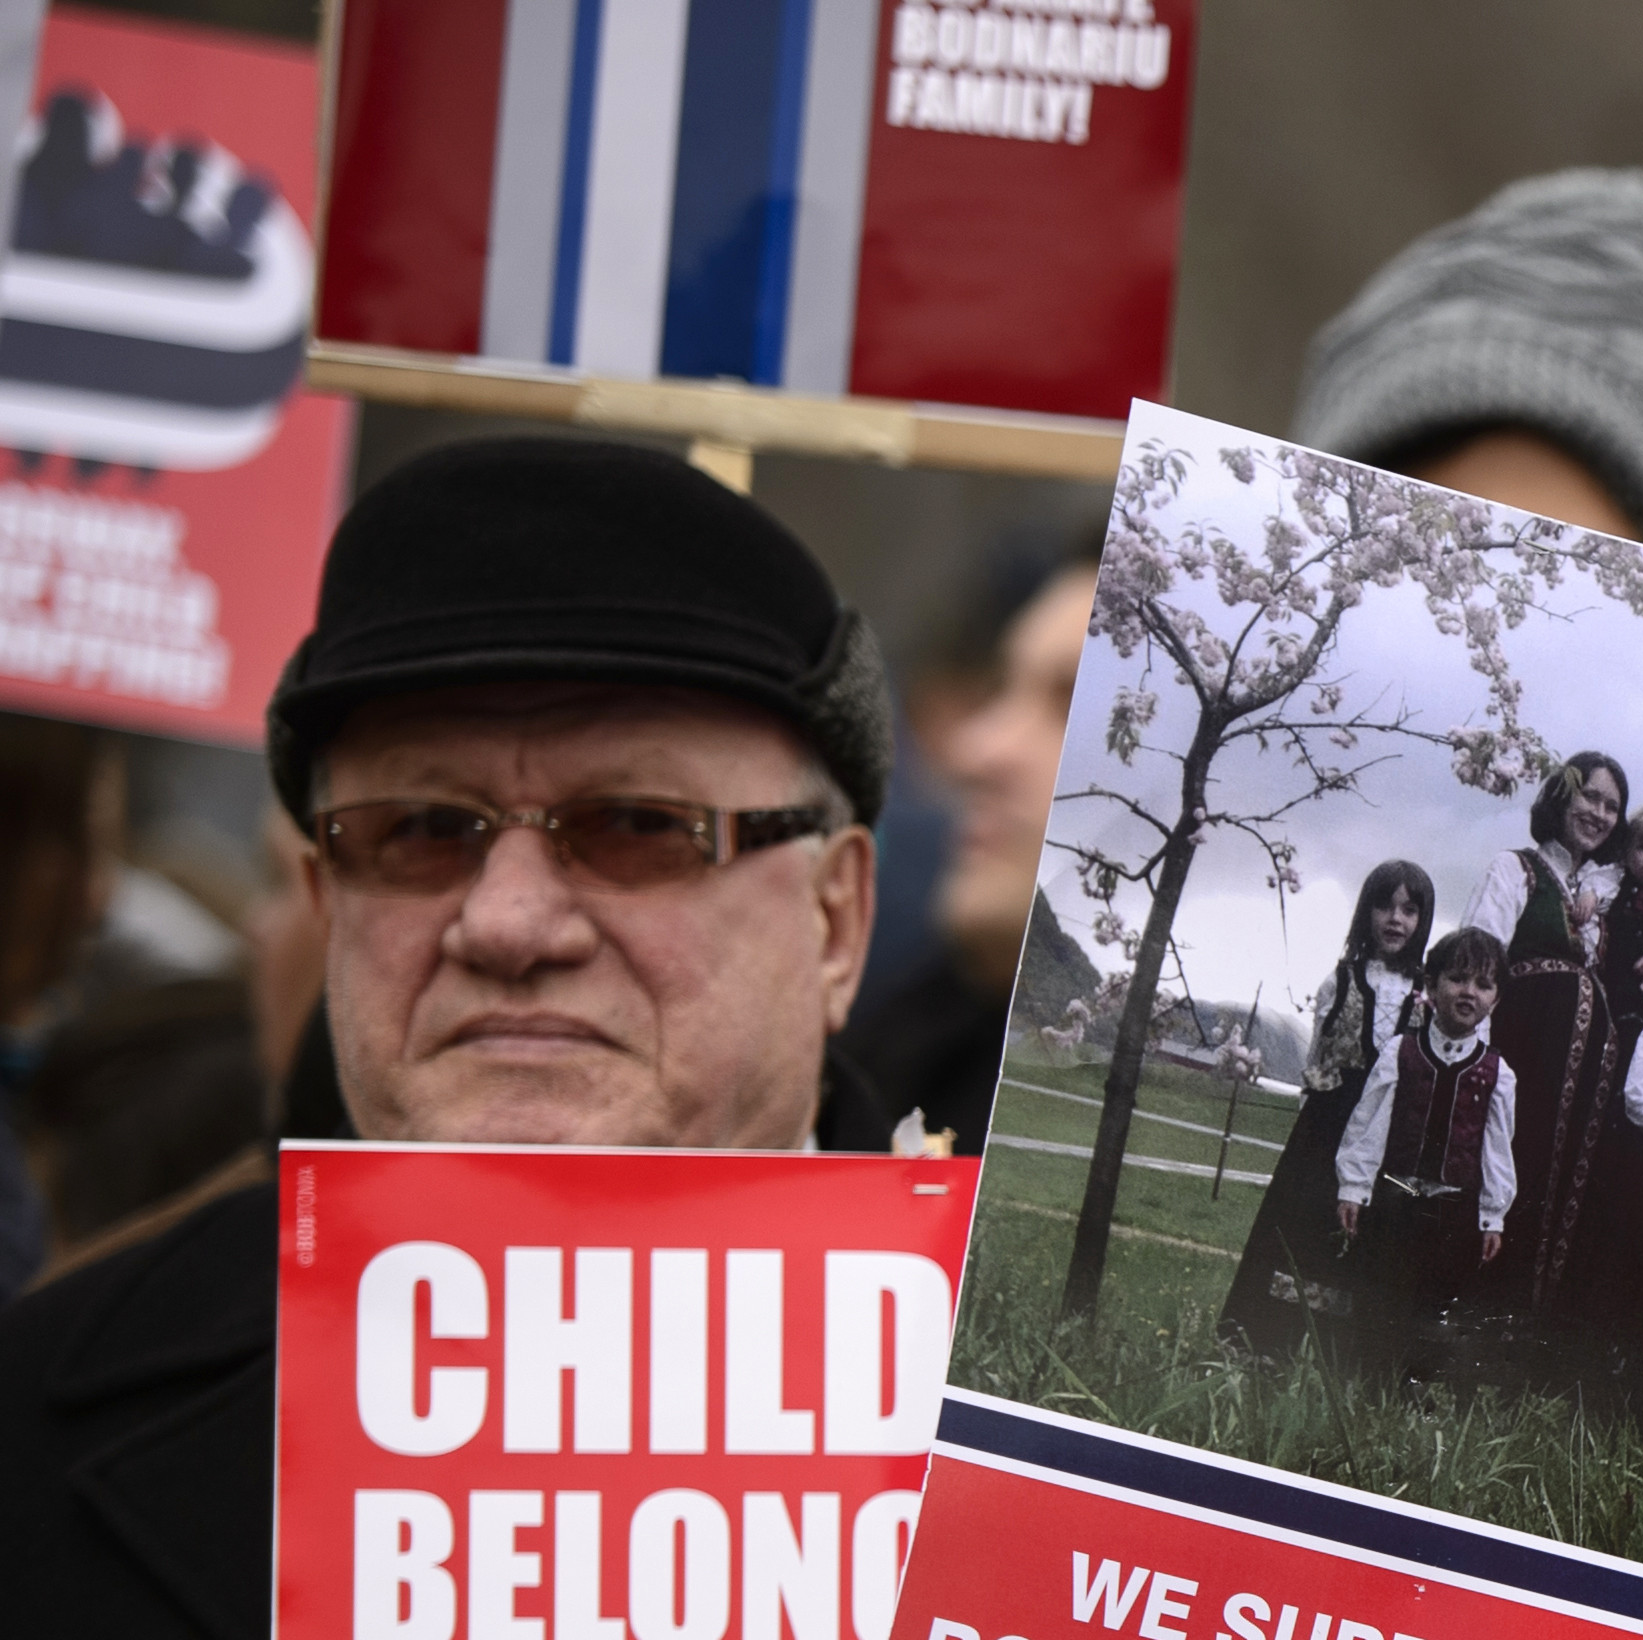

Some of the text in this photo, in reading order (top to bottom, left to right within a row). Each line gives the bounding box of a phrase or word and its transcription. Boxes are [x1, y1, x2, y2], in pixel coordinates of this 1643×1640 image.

[894, 5, 1171, 90] BODNARIU
[886, 66, 1093, 146] FAMILY!
[356, 1241, 952, 1457] CHILD
